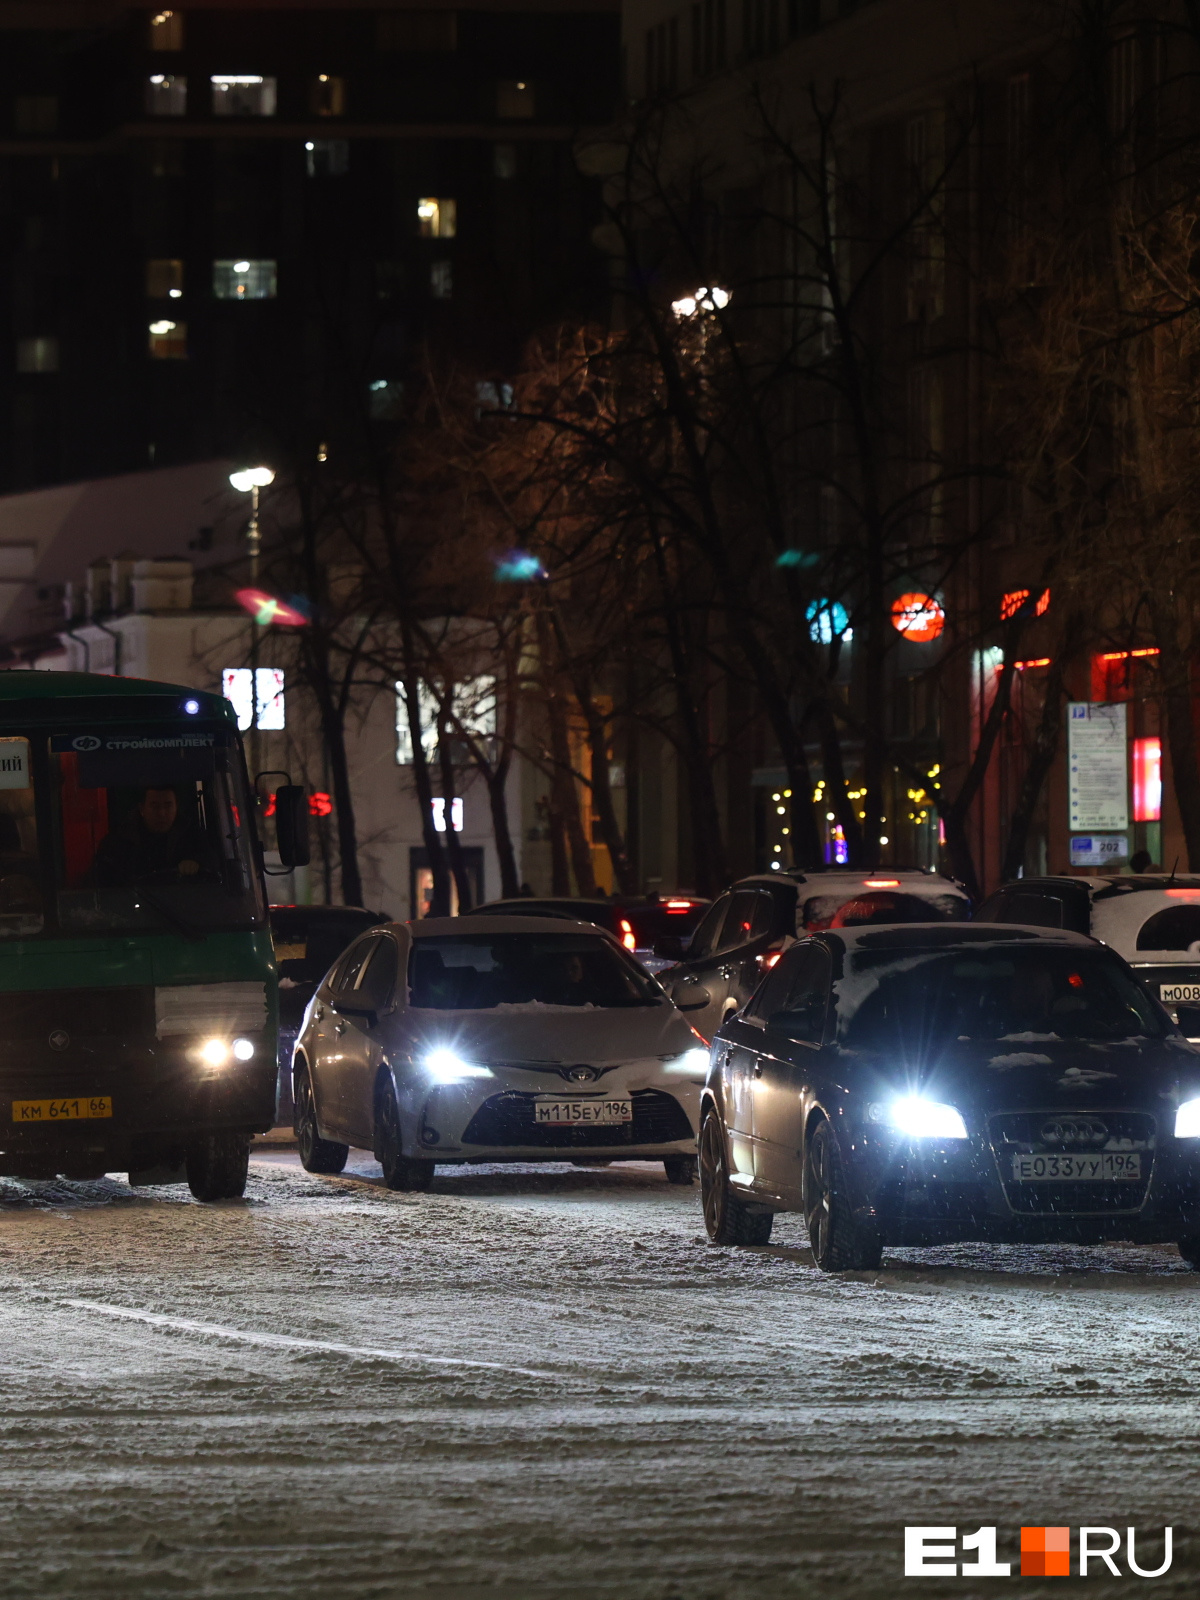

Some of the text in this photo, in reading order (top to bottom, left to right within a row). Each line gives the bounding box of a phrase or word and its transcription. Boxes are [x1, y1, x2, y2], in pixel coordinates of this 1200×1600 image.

[105, 738, 215, 750] СТРОЙКОМПЛЕКТ
[1100, 843, 1119, 852] 202
[540, 1102, 628, 1120] М115ЕУ 196
[1020, 1155, 1137, 1177] Е033УУ 196
